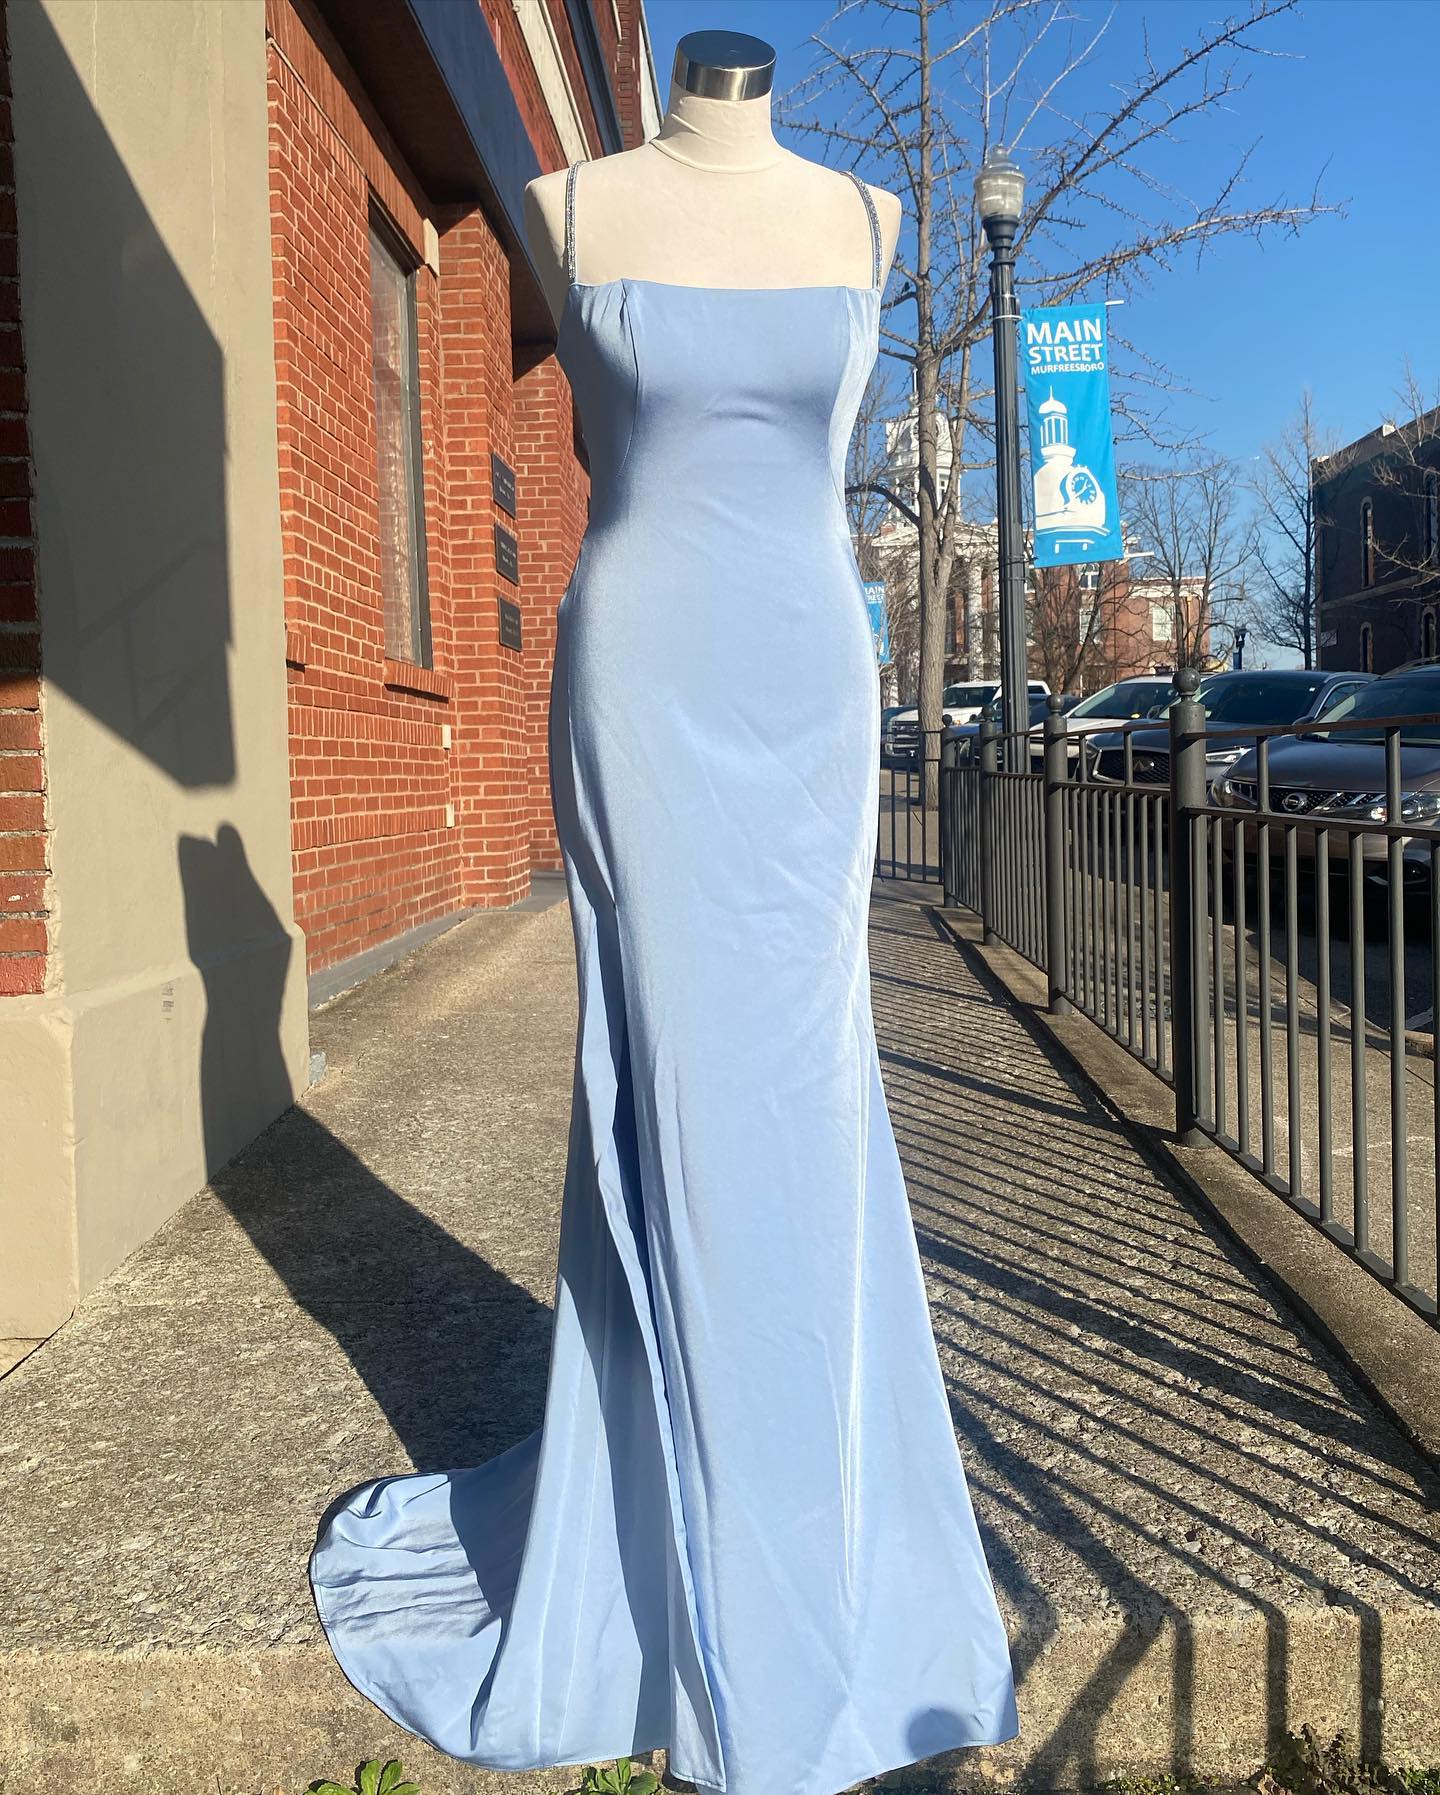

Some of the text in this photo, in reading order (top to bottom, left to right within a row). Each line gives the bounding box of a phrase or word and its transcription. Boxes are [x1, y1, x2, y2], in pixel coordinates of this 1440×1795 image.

[1027, 319, 1102, 344] MAIN
[1028, 343, 1103, 365] STREET
[1031, 362, 1104, 375] MURFREESBORO
